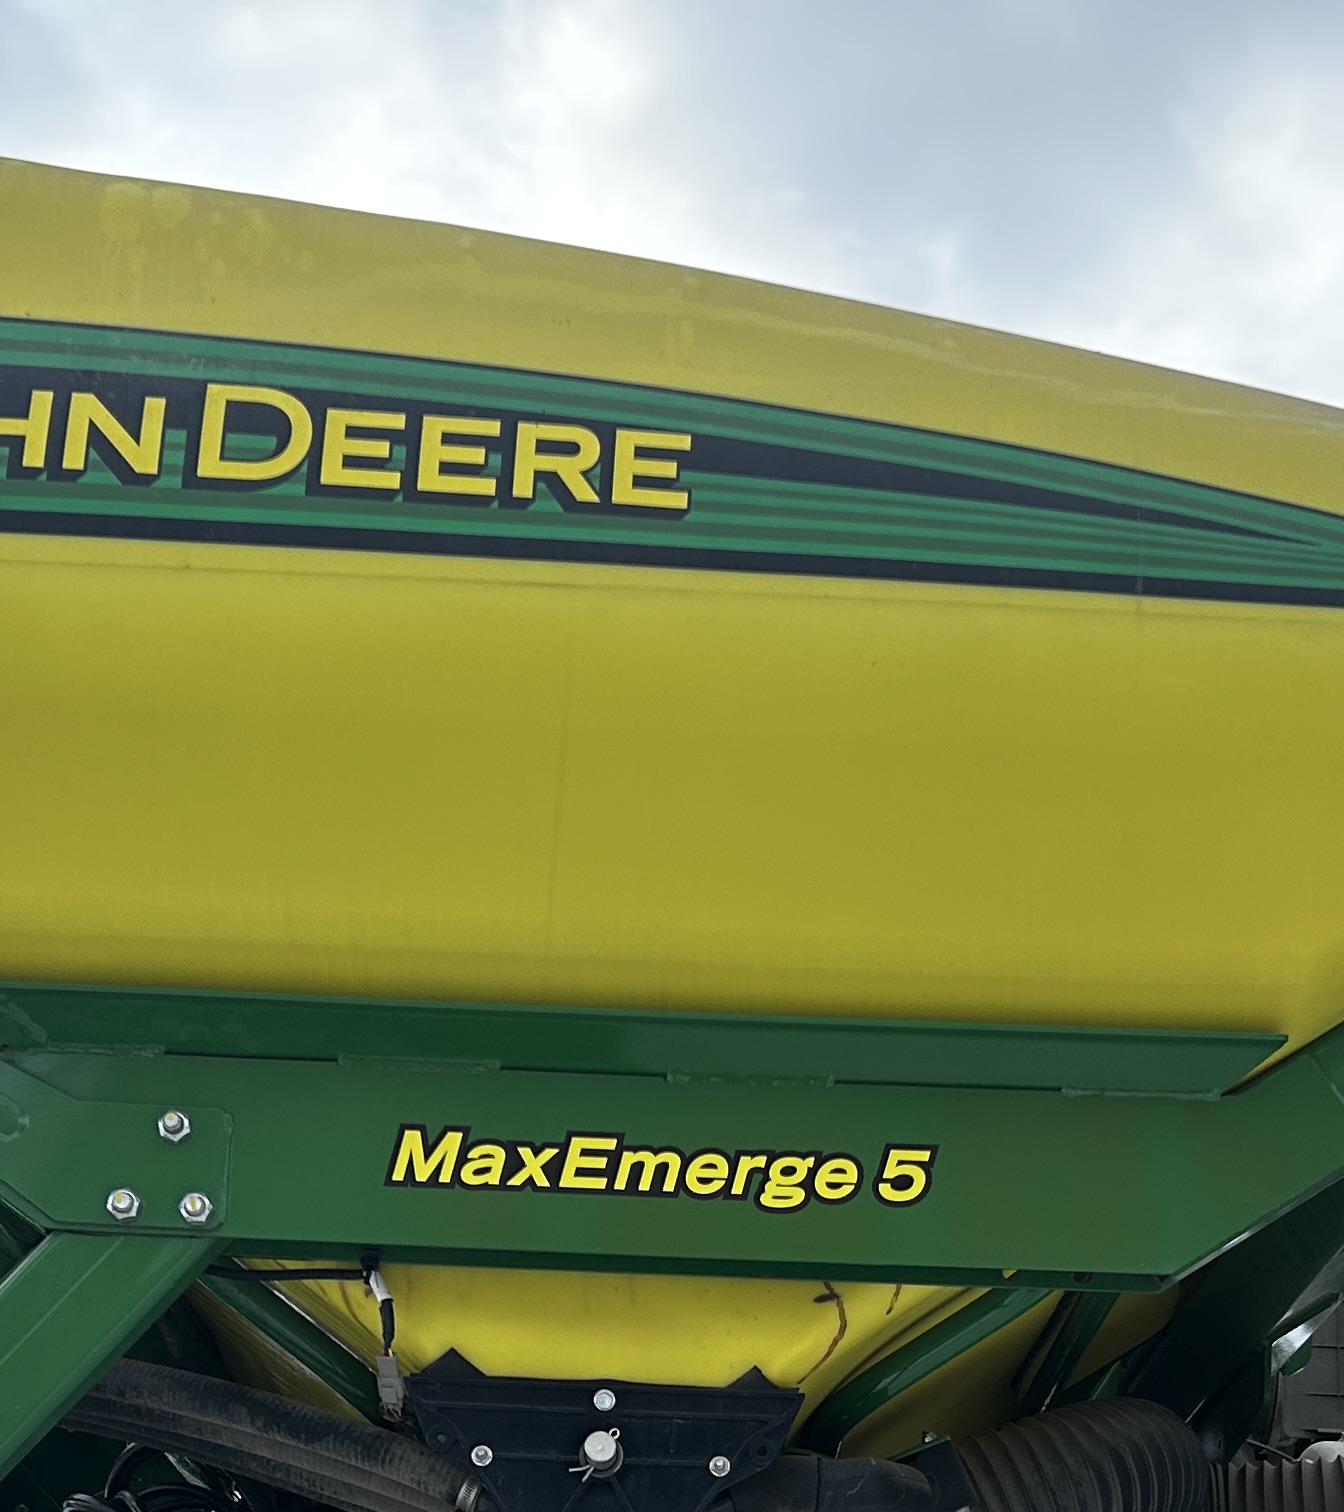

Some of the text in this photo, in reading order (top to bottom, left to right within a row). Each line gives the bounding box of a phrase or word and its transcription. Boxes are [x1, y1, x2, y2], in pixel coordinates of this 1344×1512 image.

[196, 382, 692, 511] DEERE
[391, 1129, 933, 1210] MaxEmerge 5
